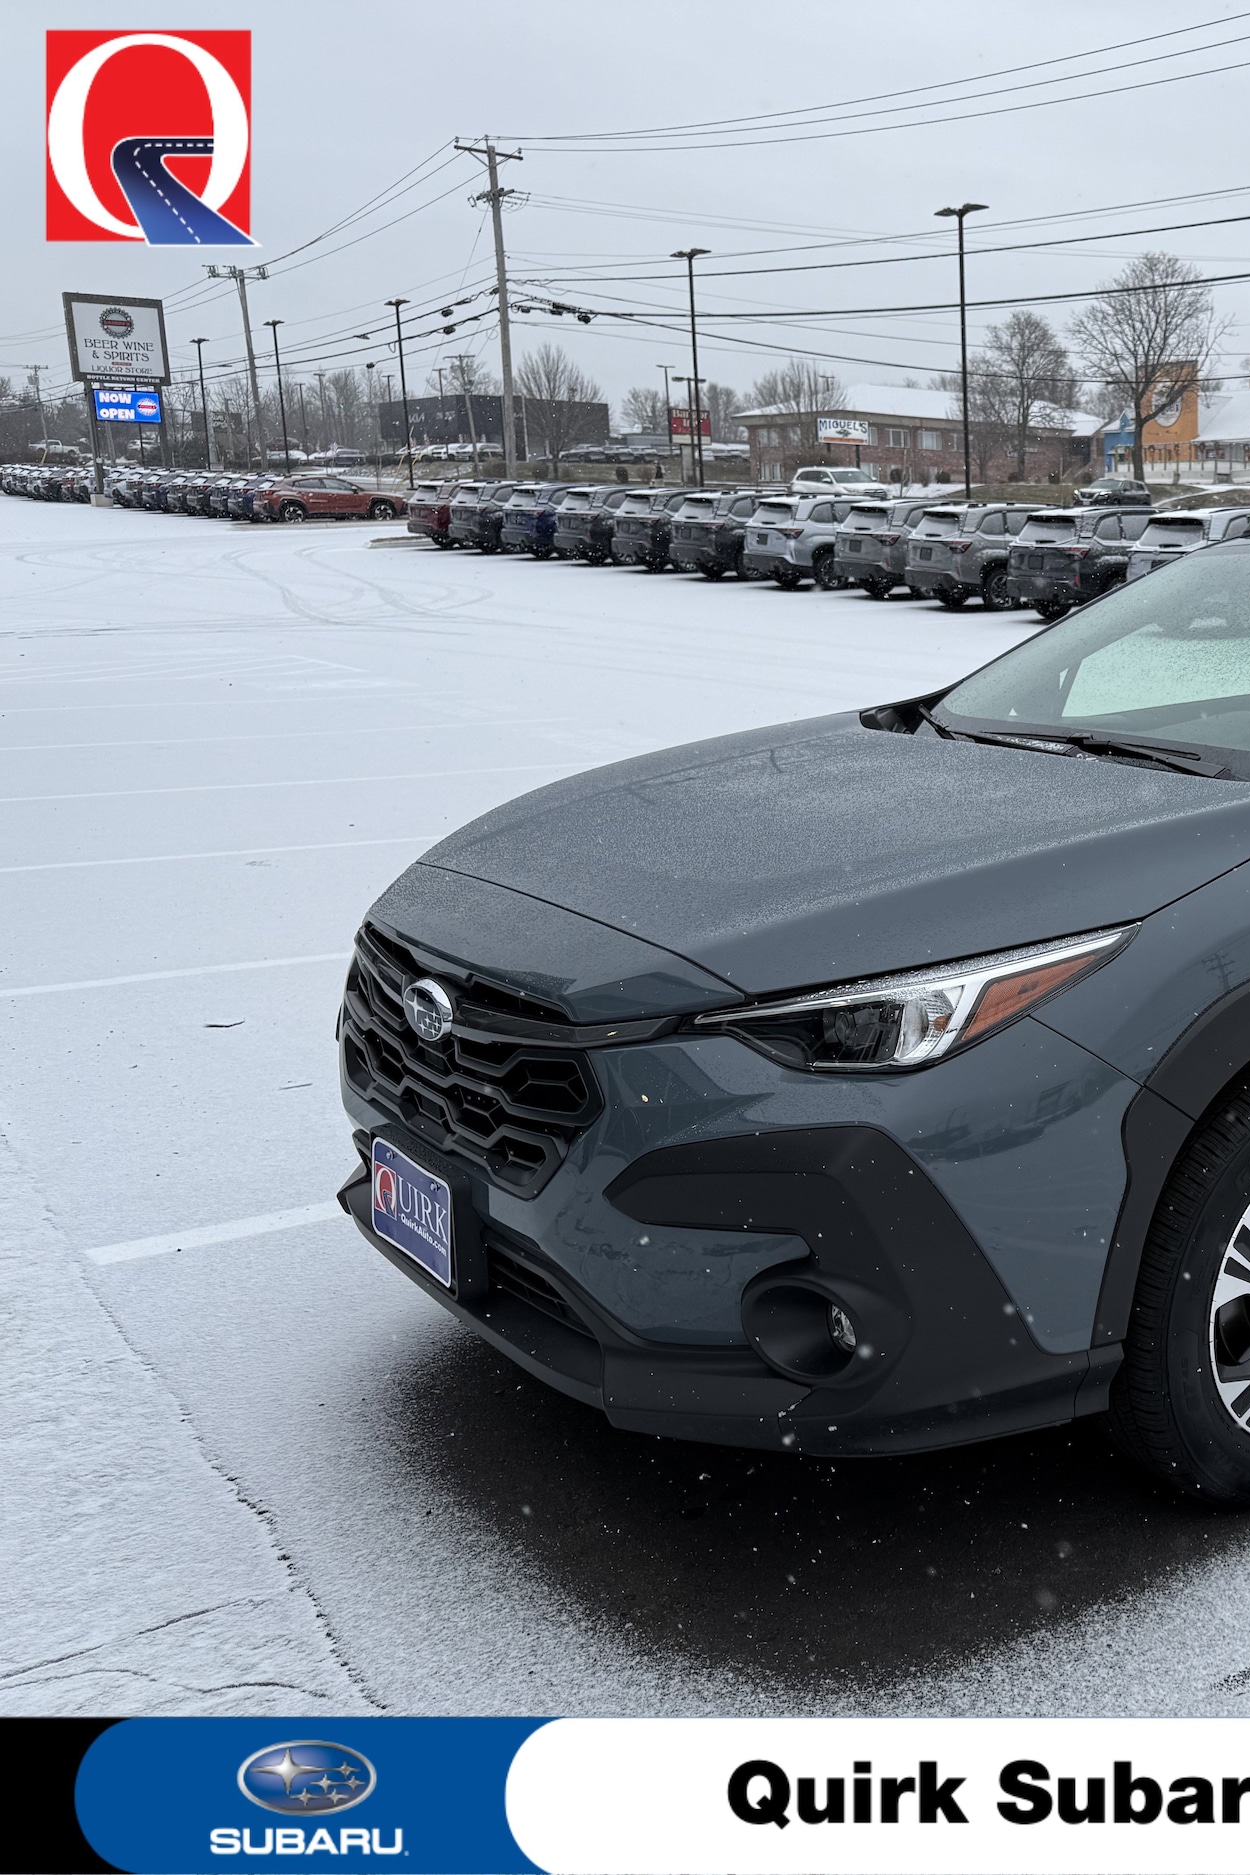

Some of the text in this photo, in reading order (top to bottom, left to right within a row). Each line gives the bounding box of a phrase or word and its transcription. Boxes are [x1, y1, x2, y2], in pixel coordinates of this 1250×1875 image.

[84, 338, 154, 352] BEER WINE
[92, 350, 150, 362] & SPIRITS
[91, 365, 153, 375] LIQUOR STORE
[98, 392, 132, 404] NOW
[99, 408, 135, 420] OPEN
[819, 419, 867, 434] MIGUEL'S
[375, 1166, 448, 1244] QUIRK
[400, 1214, 447, 1257] QuirkAuto.com
